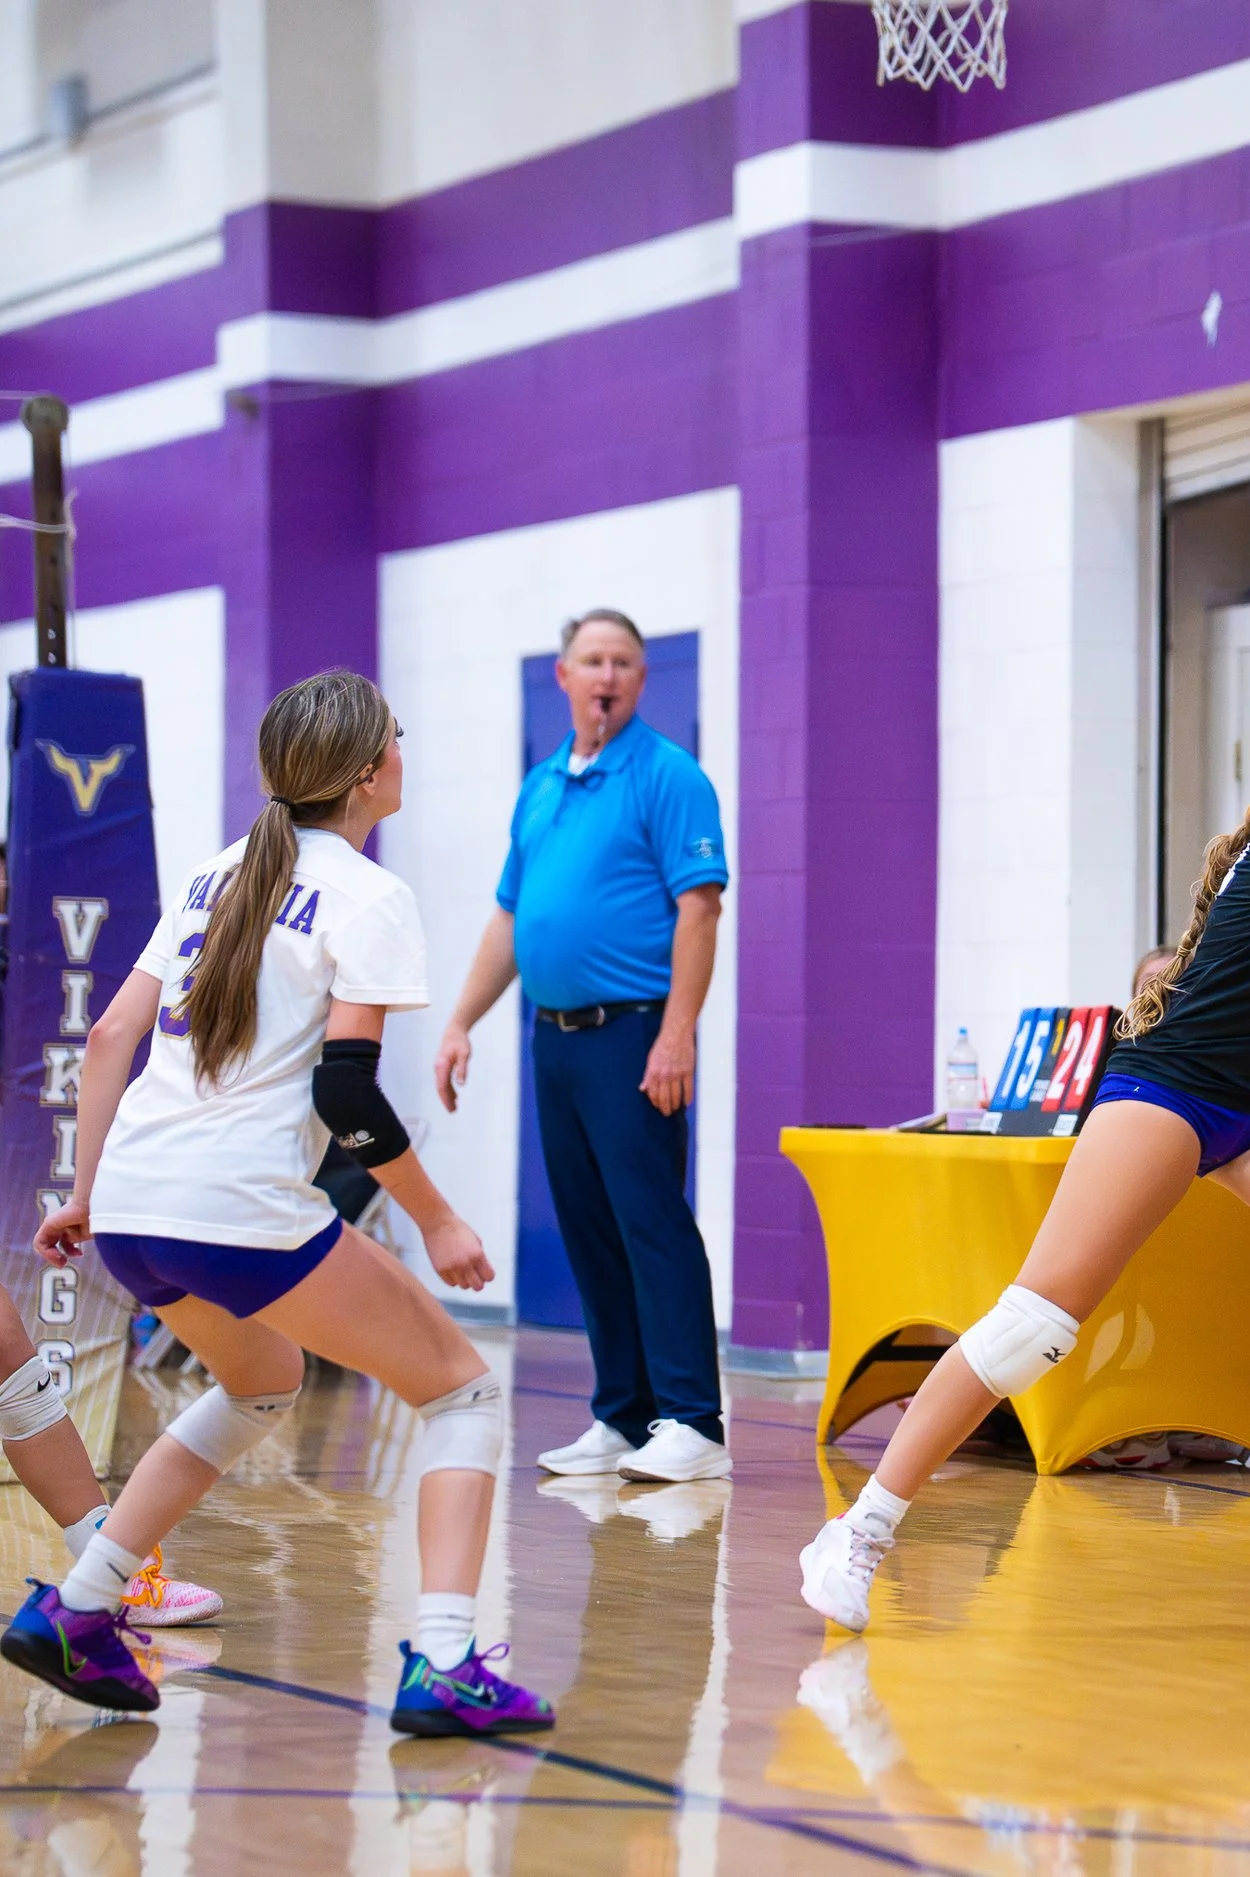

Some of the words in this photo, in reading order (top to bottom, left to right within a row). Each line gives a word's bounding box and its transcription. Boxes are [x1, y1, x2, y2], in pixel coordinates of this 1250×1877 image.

[39, 896, 109, 1396] VIKIGS
[1001, 1020, 1050, 1098] 15
[1046, 1016, 1103, 1099] 24
